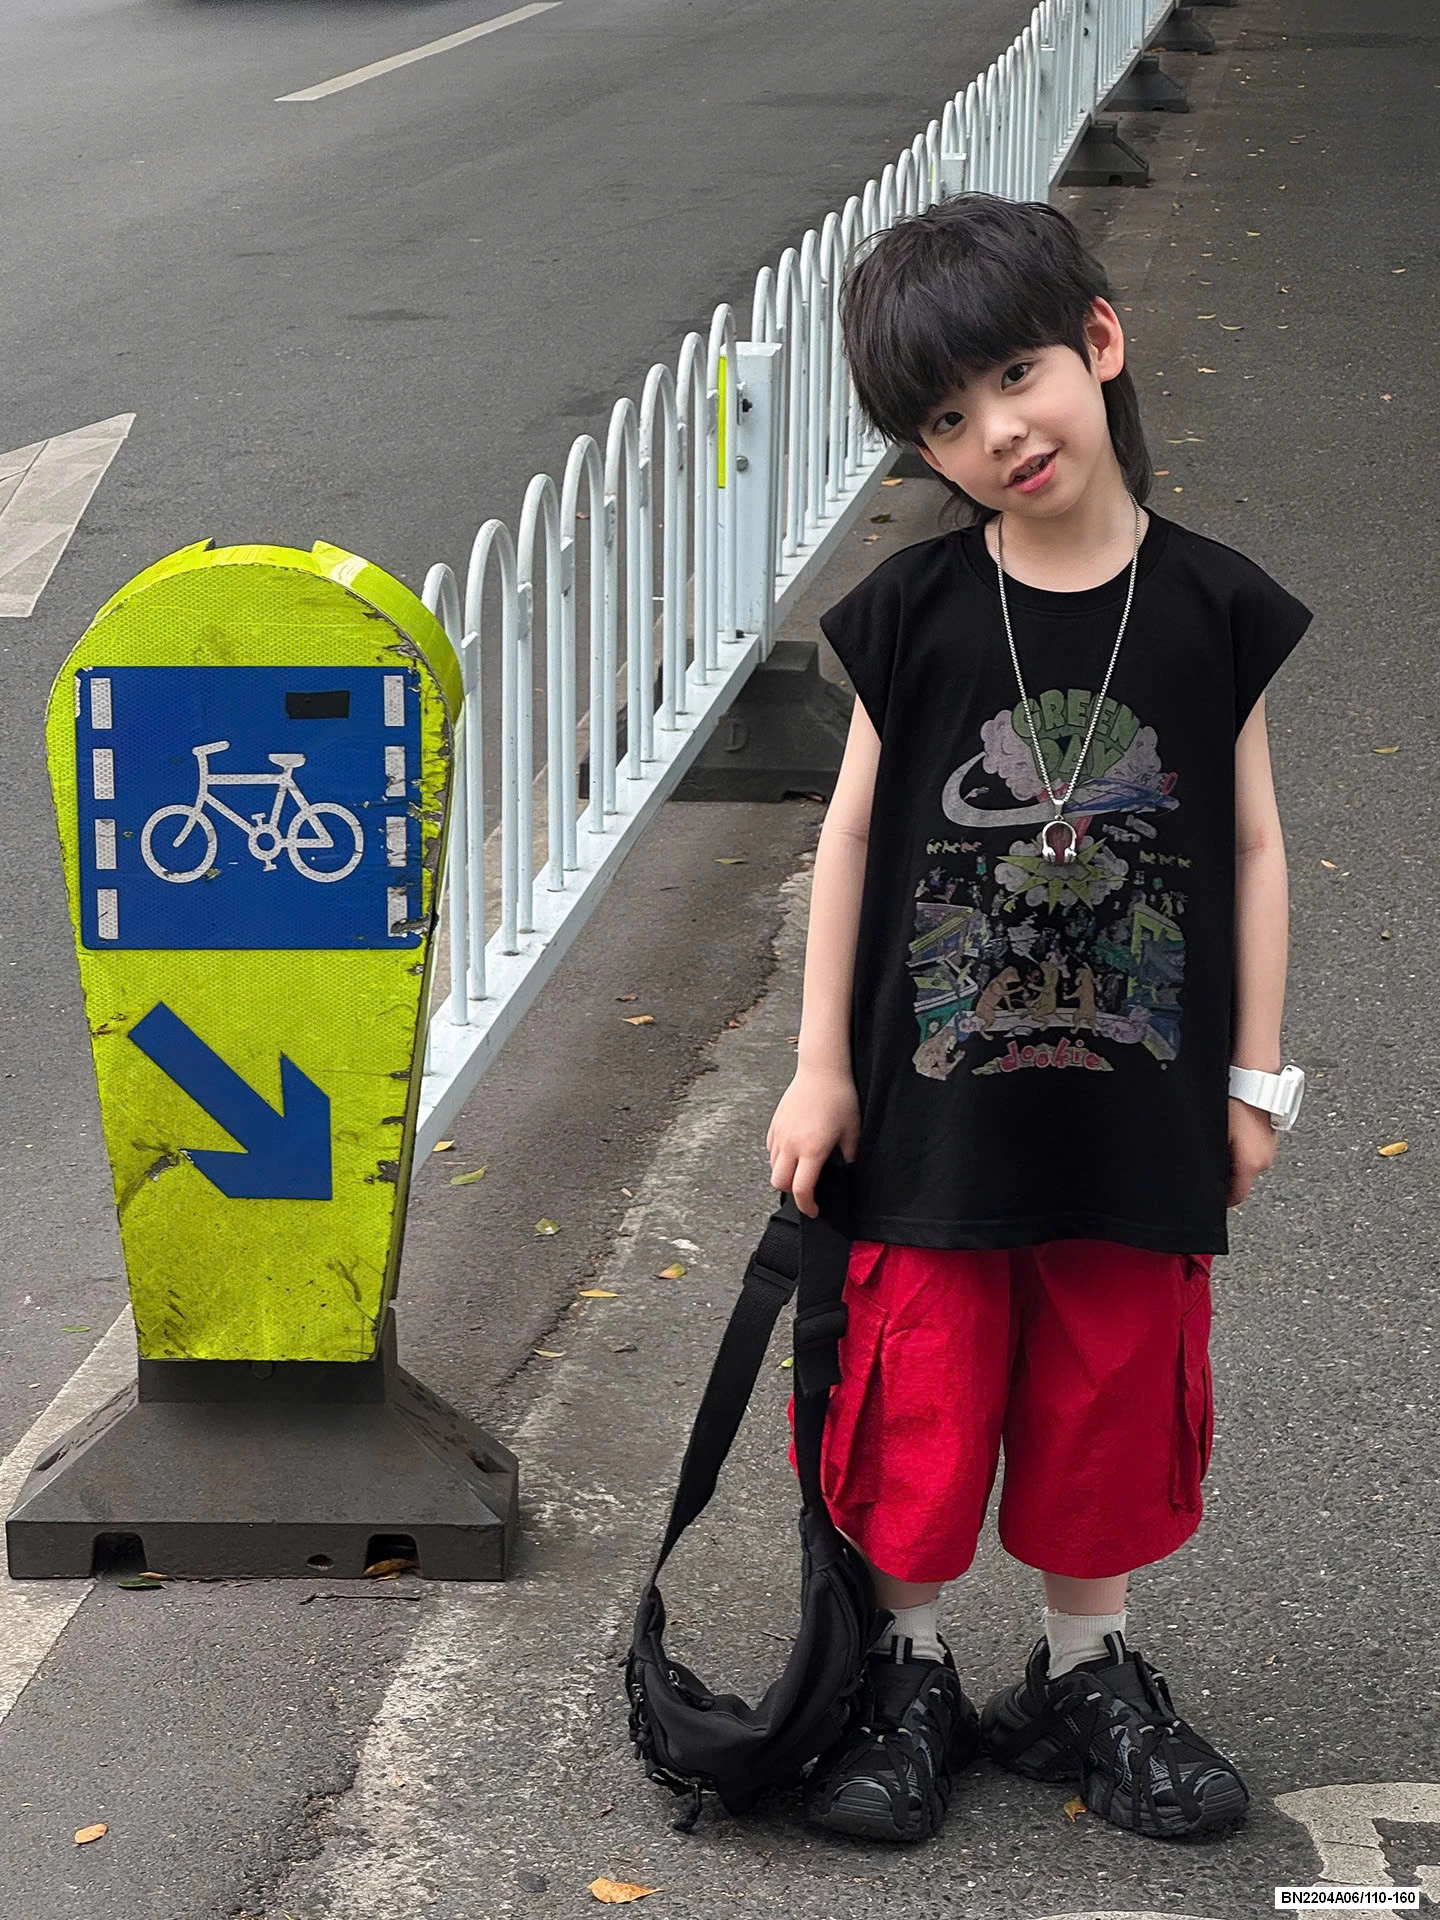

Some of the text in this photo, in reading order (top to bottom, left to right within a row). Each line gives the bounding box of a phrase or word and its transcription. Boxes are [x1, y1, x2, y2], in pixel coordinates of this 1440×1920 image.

[1011, 688, 1141, 750] GREEN
[1032, 733, 1125, 779] DAY
[999, 1036, 1101, 1073] dookie
